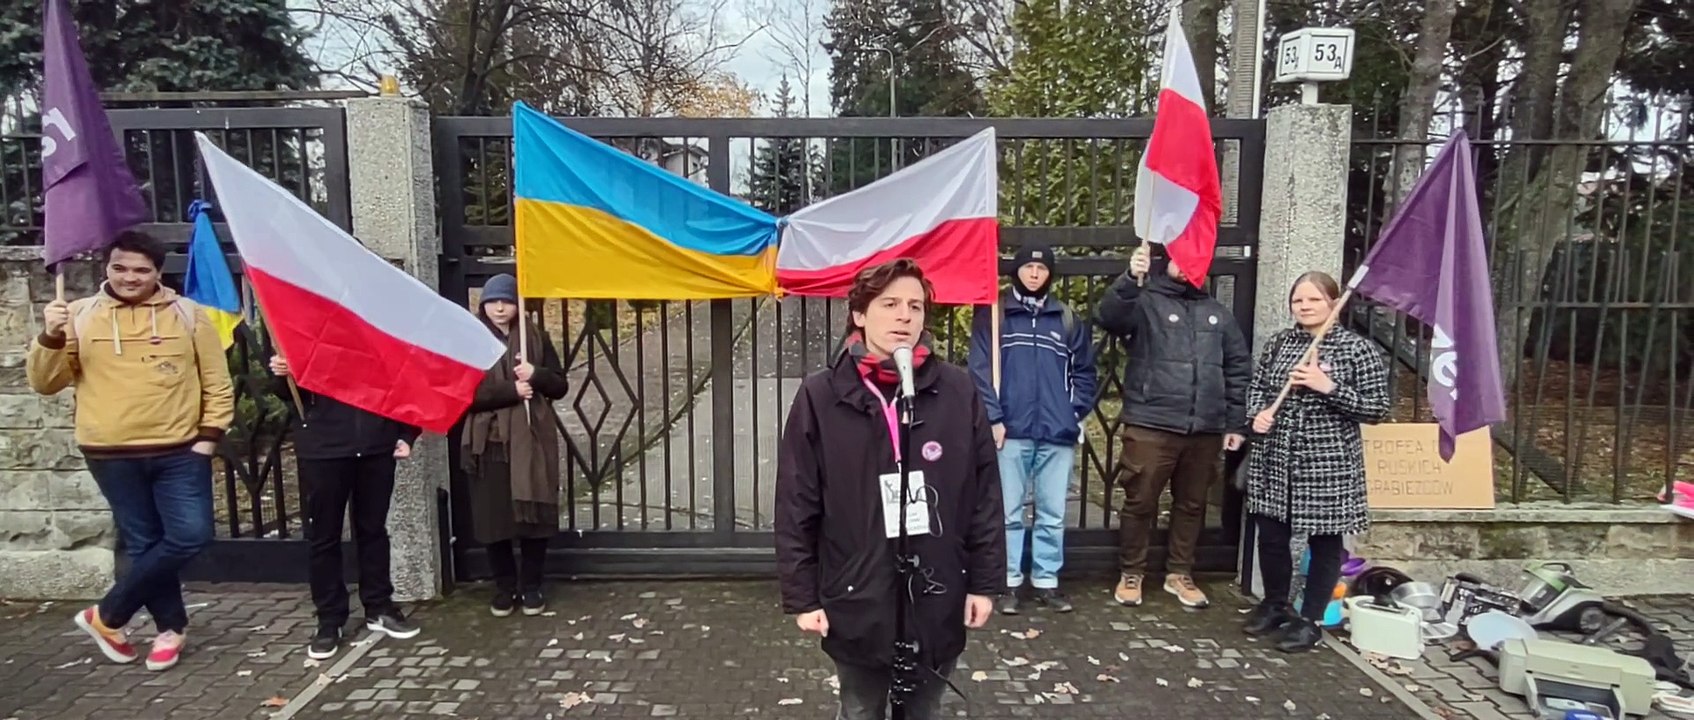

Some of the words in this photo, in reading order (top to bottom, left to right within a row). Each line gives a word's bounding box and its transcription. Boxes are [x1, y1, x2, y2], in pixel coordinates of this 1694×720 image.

[1314, 43, 1342, 69] 53A
[1363, 439, 1424, 455] TROFEA
[1377, 459, 1442, 476] RUSKICH
